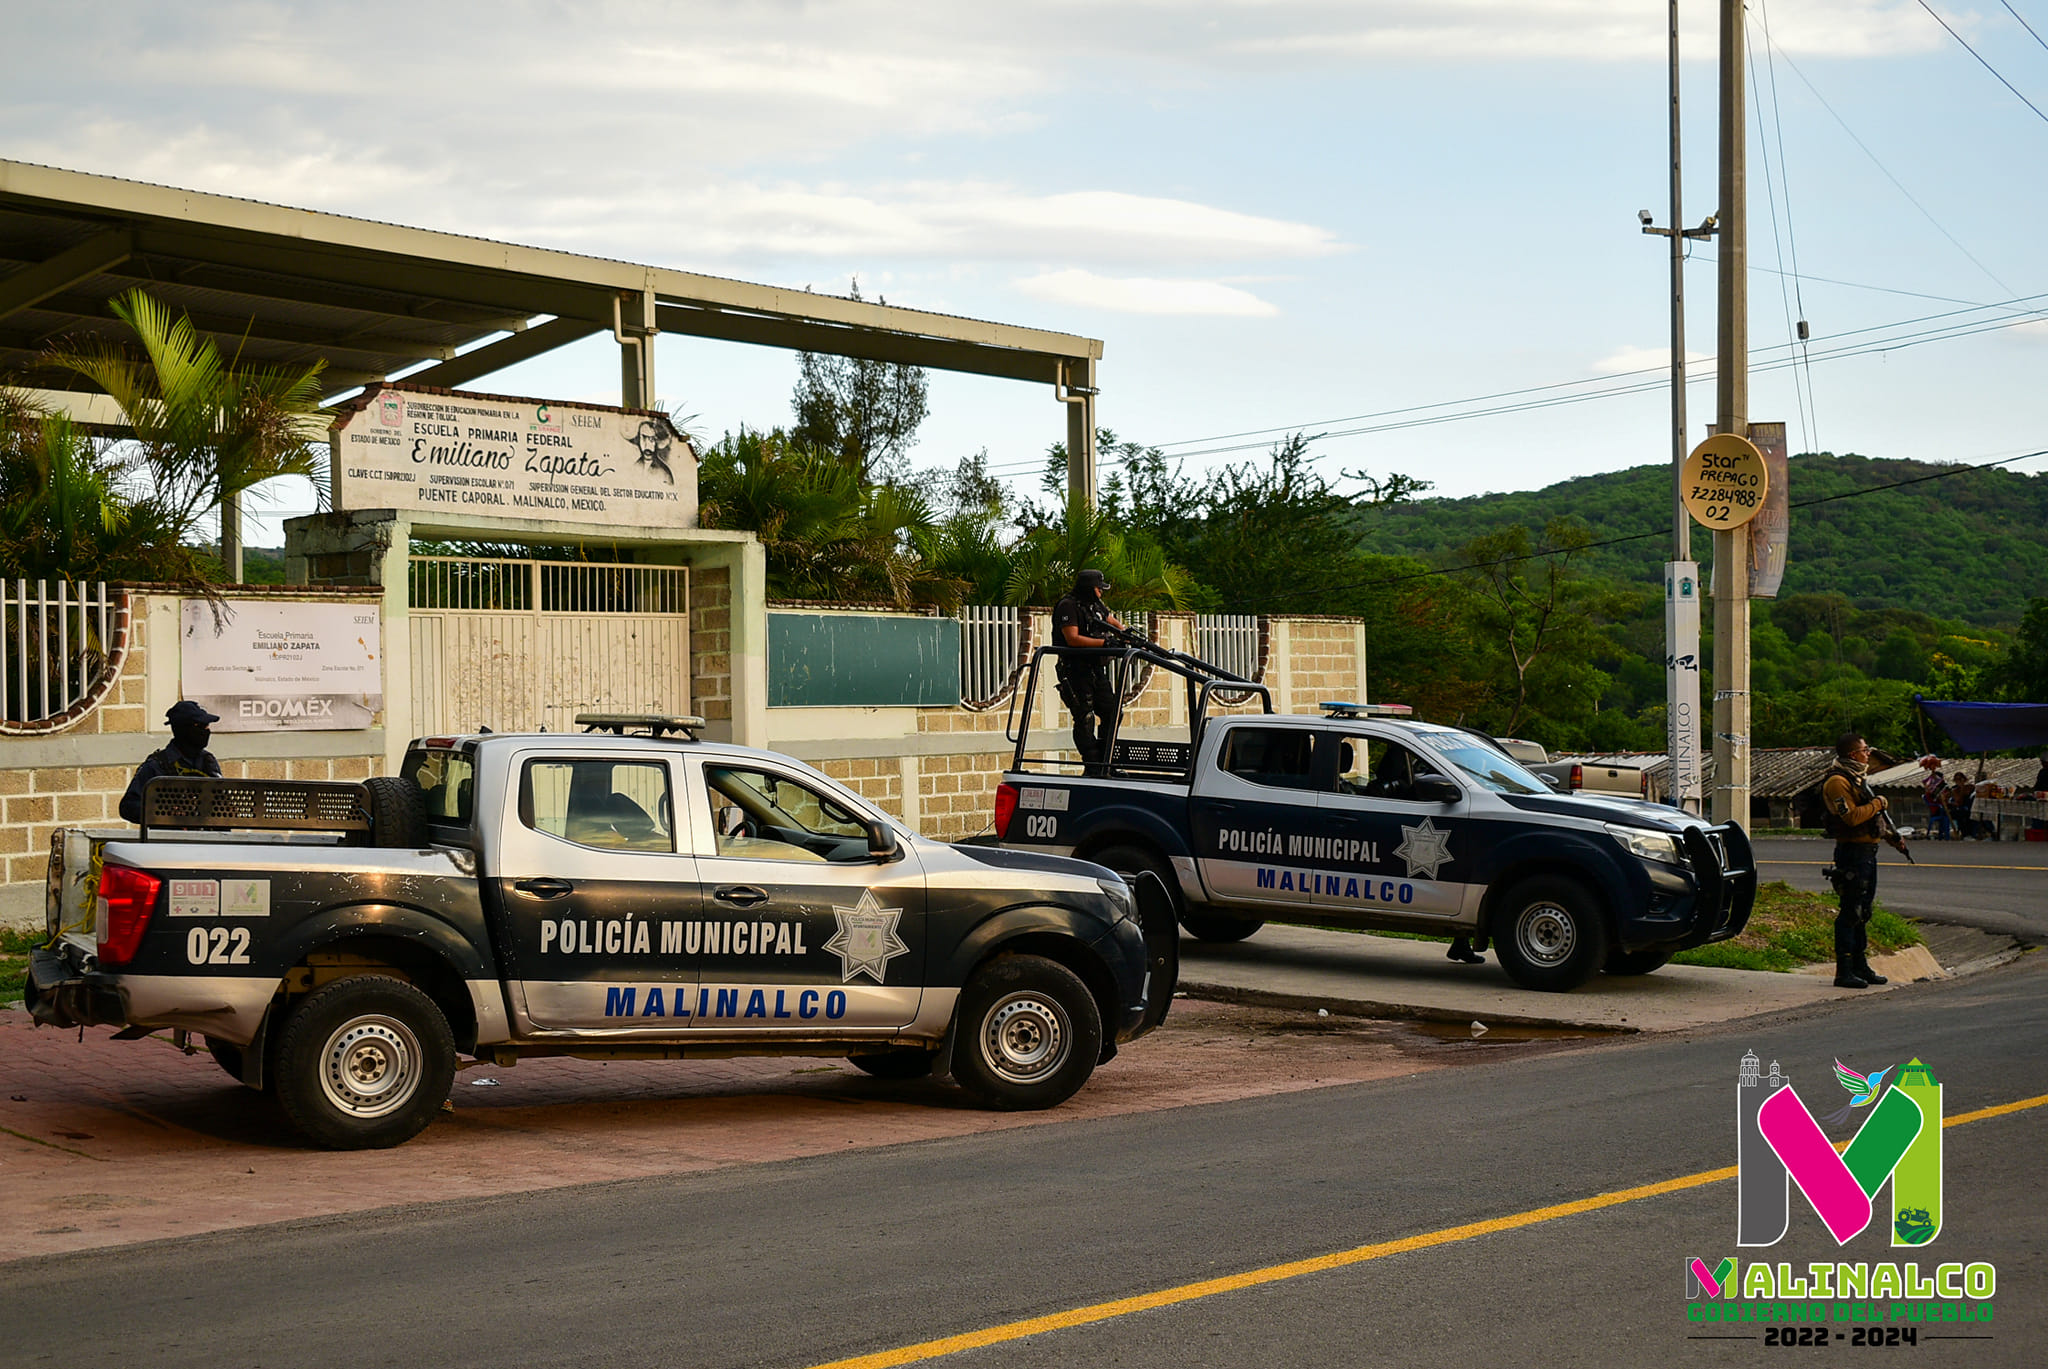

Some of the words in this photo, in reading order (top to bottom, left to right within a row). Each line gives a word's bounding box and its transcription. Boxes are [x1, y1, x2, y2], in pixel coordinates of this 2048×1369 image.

[427, 412, 434, 420] DE
[450, 406, 477, 415] EDUCACION
[478, 408, 502, 418] PRIMARIA
[503, 411, 511, 419] EN
[511, 412, 520, 420] LA
[571, 414, 601, 429] SEIEM
[351, 434, 371, 444] ESTADO
[371, 436, 378, 444] DE
[379, 436, 401, 446] MEXICO
[414, 422, 460, 438] ESCUELA
[468, 427, 519, 443] PRIMARIA
[526, 433, 573, 449] FEDERAL
[348, 468, 368, 479] CLAVE
[1700, 470, 1759, 487] PREPAGO
[429, 475, 470, 487] SUPERVISION
[471, 478, 497, 489] ESCOLAR
[418, 487, 458, 503] PUENTE
[529, 482, 569, 494] SUPERVISION
[570, 485, 598, 496] GENERAL
[600, 487, 611, 497] DEL
[612, 488, 633, 498] SECTOR
[634, 489, 665, 500] EDUCATIVO
[1706, 506, 1730, 522] 02
[353, 615, 375, 625] SEIEM
[258, 631, 284, 640] Escuela
[285, 631, 314, 640] Primaria
[252, 641, 289, 650] EMILIANO
[290, 642, 321, 650] ZAPATA
[239, 697, 333, 717] EDOMÉX
[1026, 815, 1057, 838] 020
[1218, 827, 1283, 855] POLICÍA
[1288, 834, 1380, 863] MUNICIPAL
[1256, 868, 1414, 904] MALINALCO
[540, 913, 651, 955] POLICÍA
[660, 920, 807, 956] MUNICIPAL
[187, 926, 251, 965] 022
[604, 987, 847, 1020] MALINALCO
